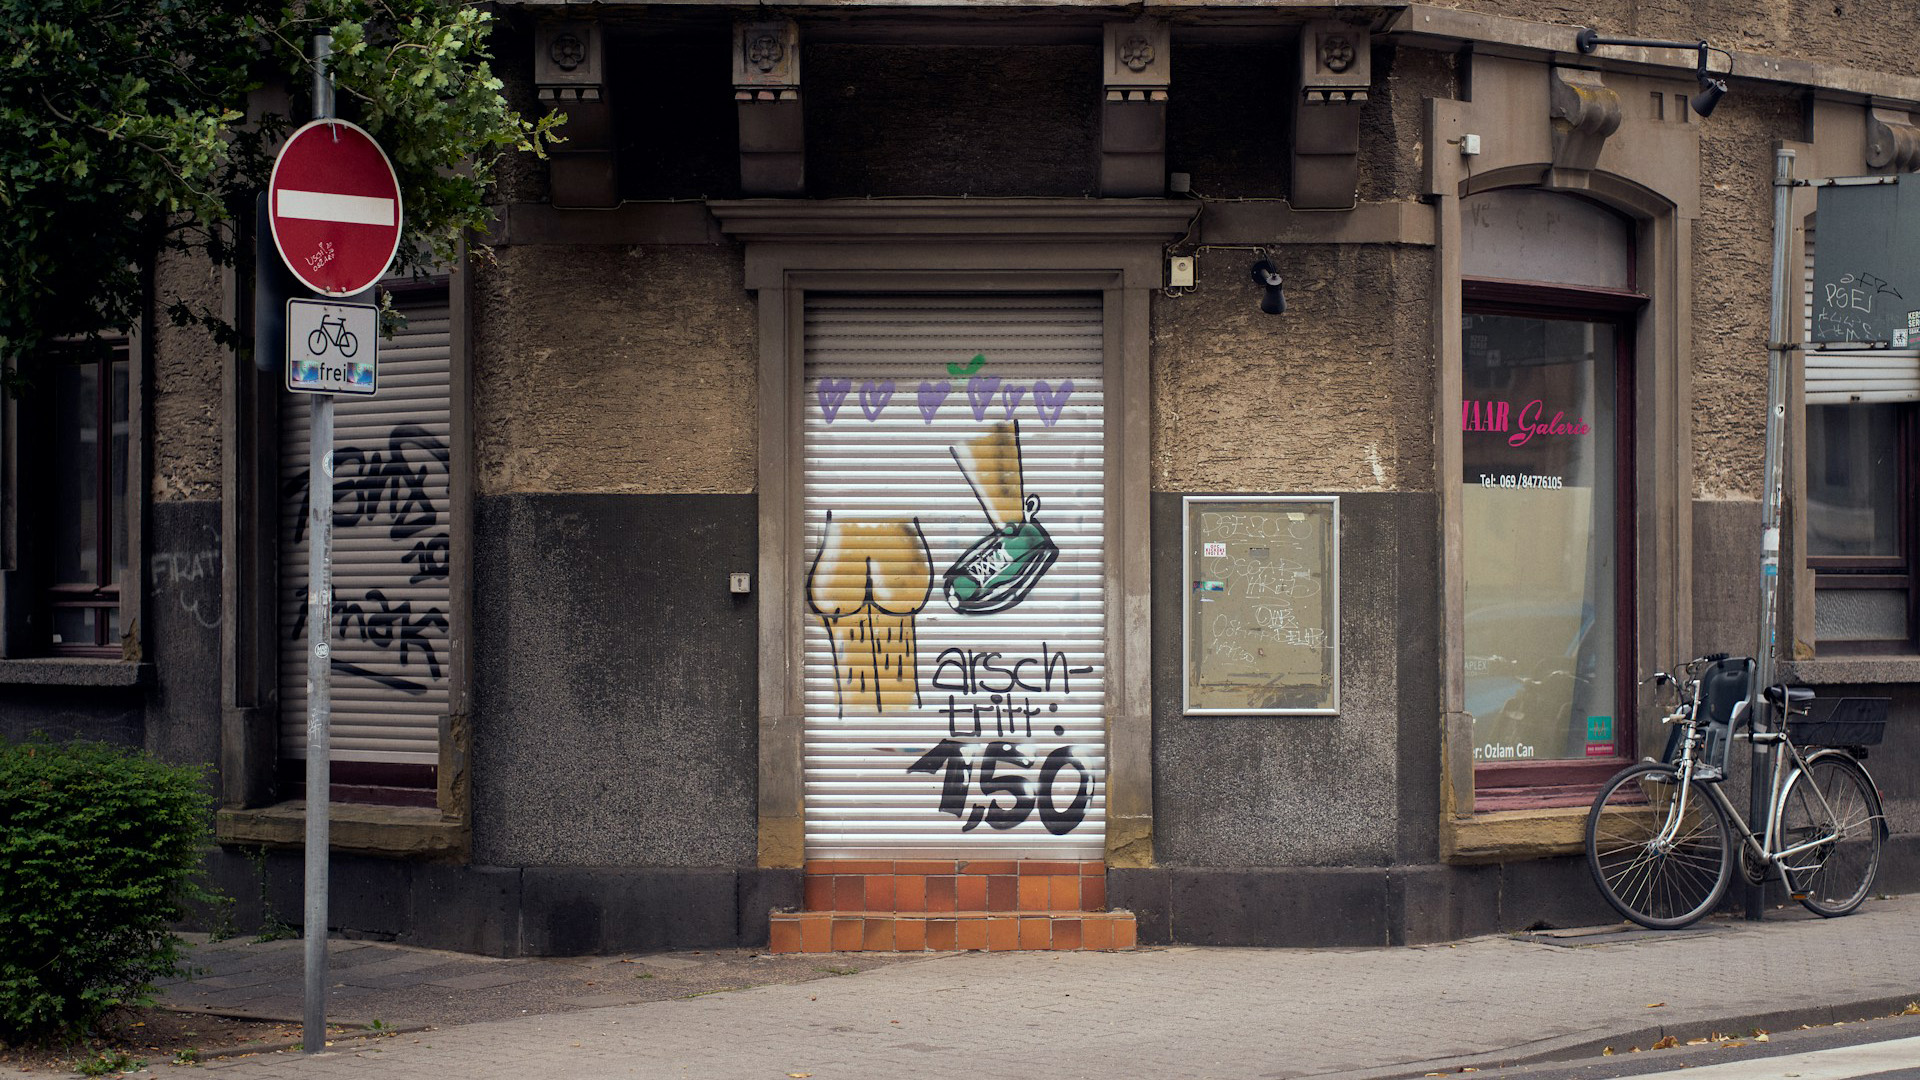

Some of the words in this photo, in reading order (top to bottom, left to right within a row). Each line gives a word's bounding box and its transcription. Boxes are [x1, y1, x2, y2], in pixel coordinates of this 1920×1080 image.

[320, 362, 346, 382] frei
[1508, 400, 1591, 447] Galerie
[1480, 473, 1496, 488] Tel:
[932, 641, 1093, 694] arsch-
[938, 694, 1065, 737] tritt:
[1473, 748, 1483, 760] r:
[1516, 742, 1535, 759] Can
[906, 738, 1095, 836] 1,50
